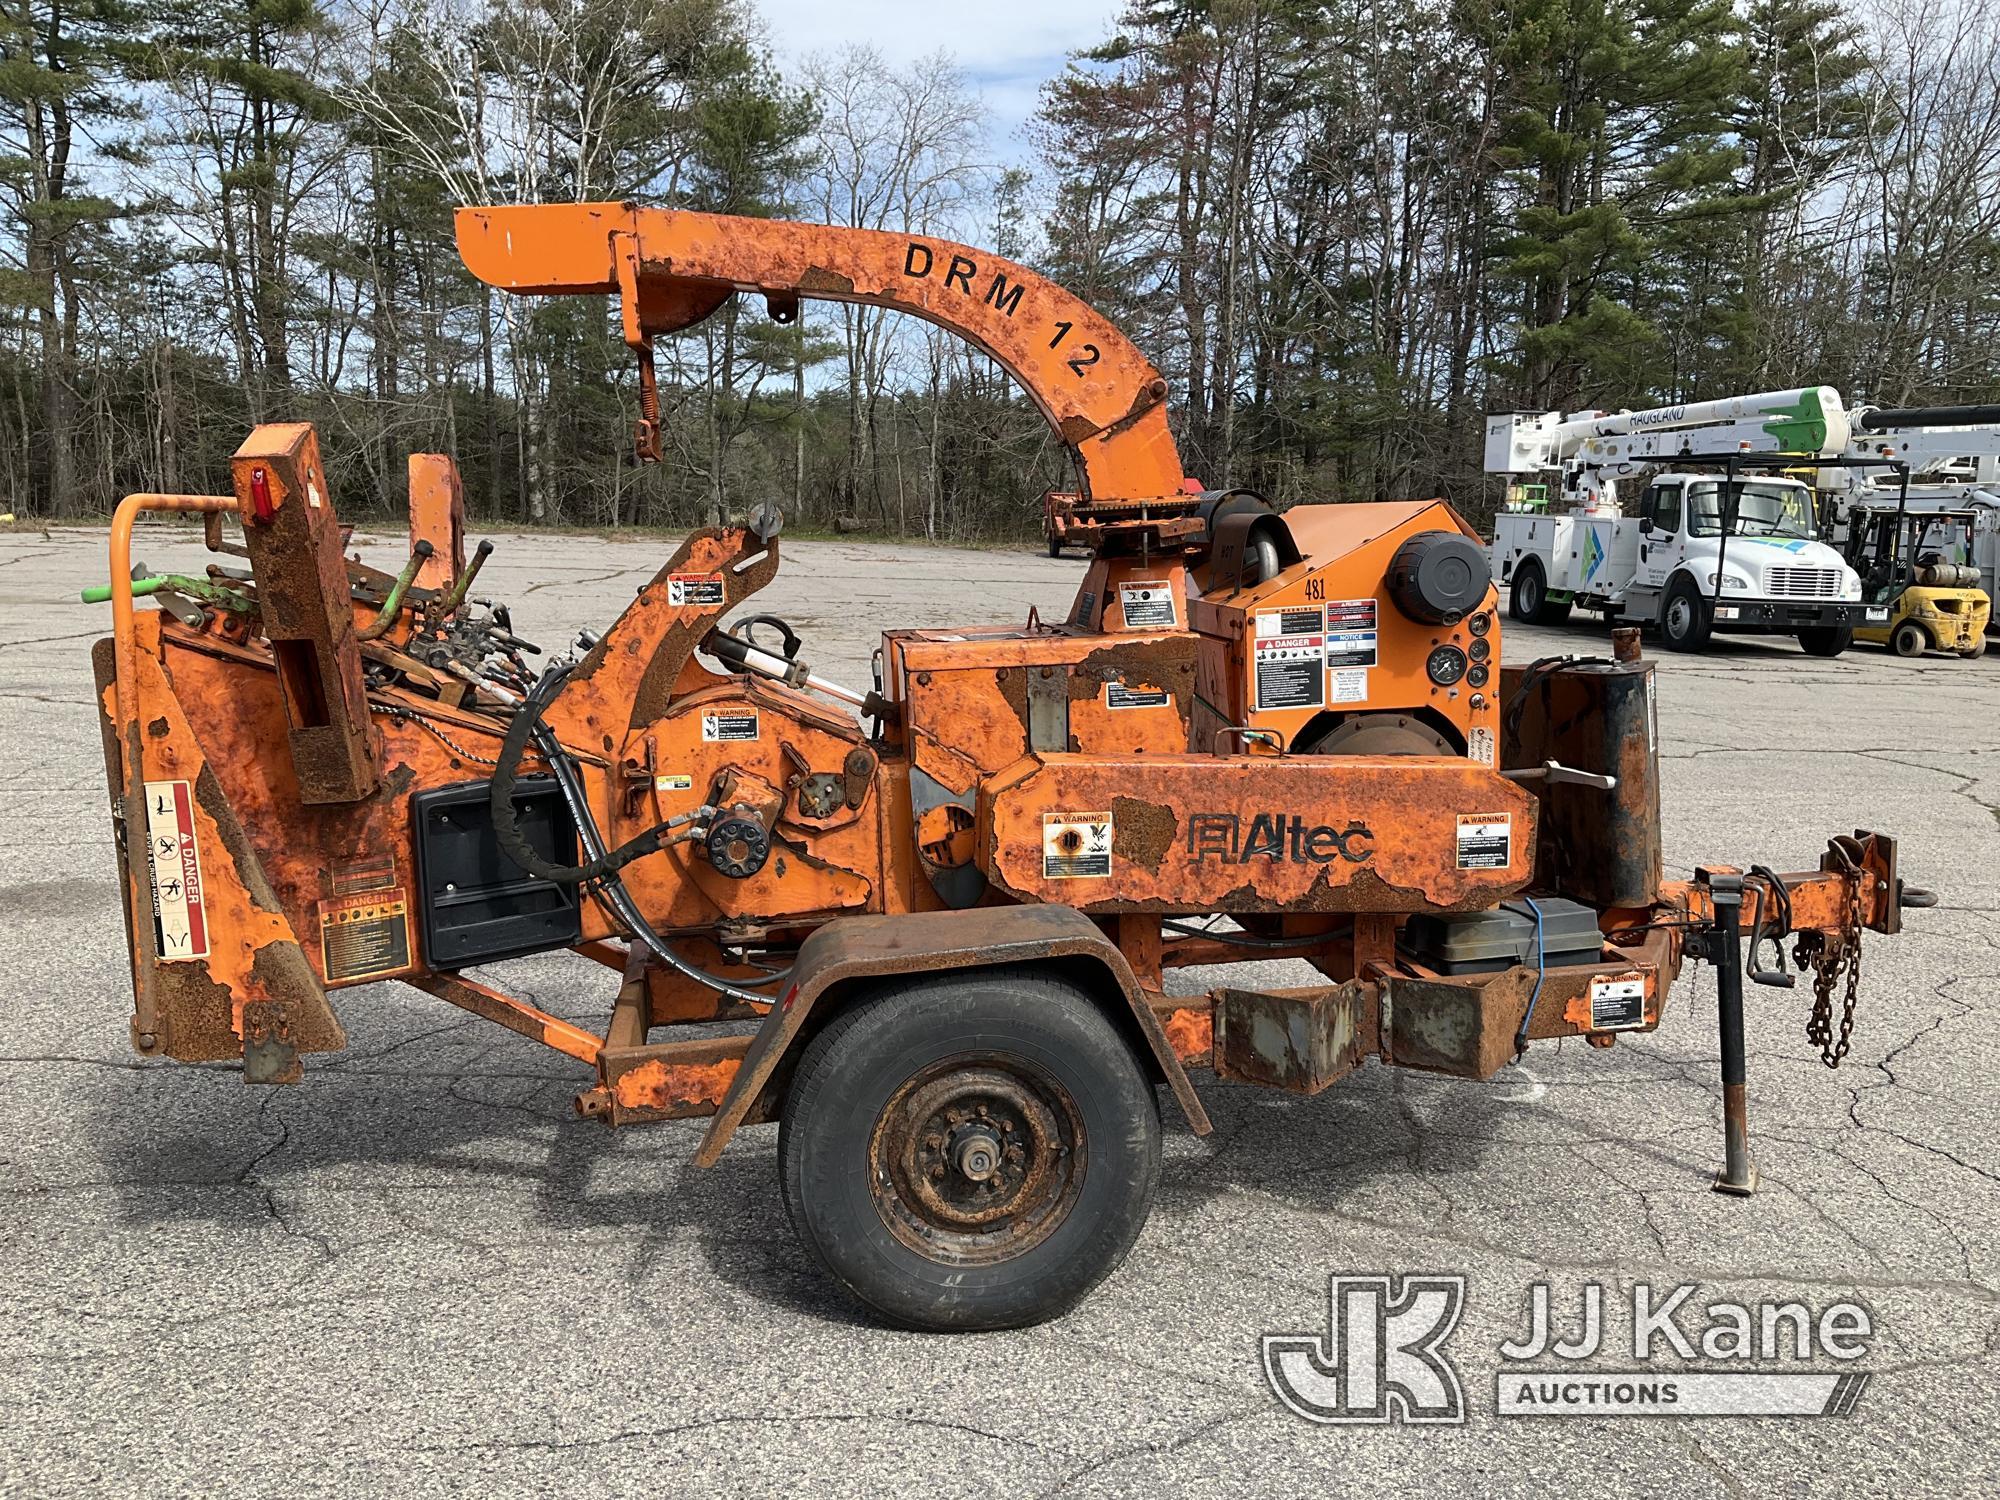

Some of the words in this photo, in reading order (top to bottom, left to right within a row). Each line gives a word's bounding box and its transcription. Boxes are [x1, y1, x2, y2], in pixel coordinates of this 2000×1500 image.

[904, 242, 1025, 317] DRM
[1048, 321, 1100, 378] 12
[1630, 407, 1685, 426] HAUGLAND
[1305, 578, 1325, 600] 481
[1275, 639, 1310, 648] DANGER
[1239, 813, 1374, 864] Altec
[149, 863, 157, 887] CRUSH
[183, 848, 199, 904] DANGER
[151, 888, 160, 917] HAZARD
[345, 894, 388, 907] DANGER
